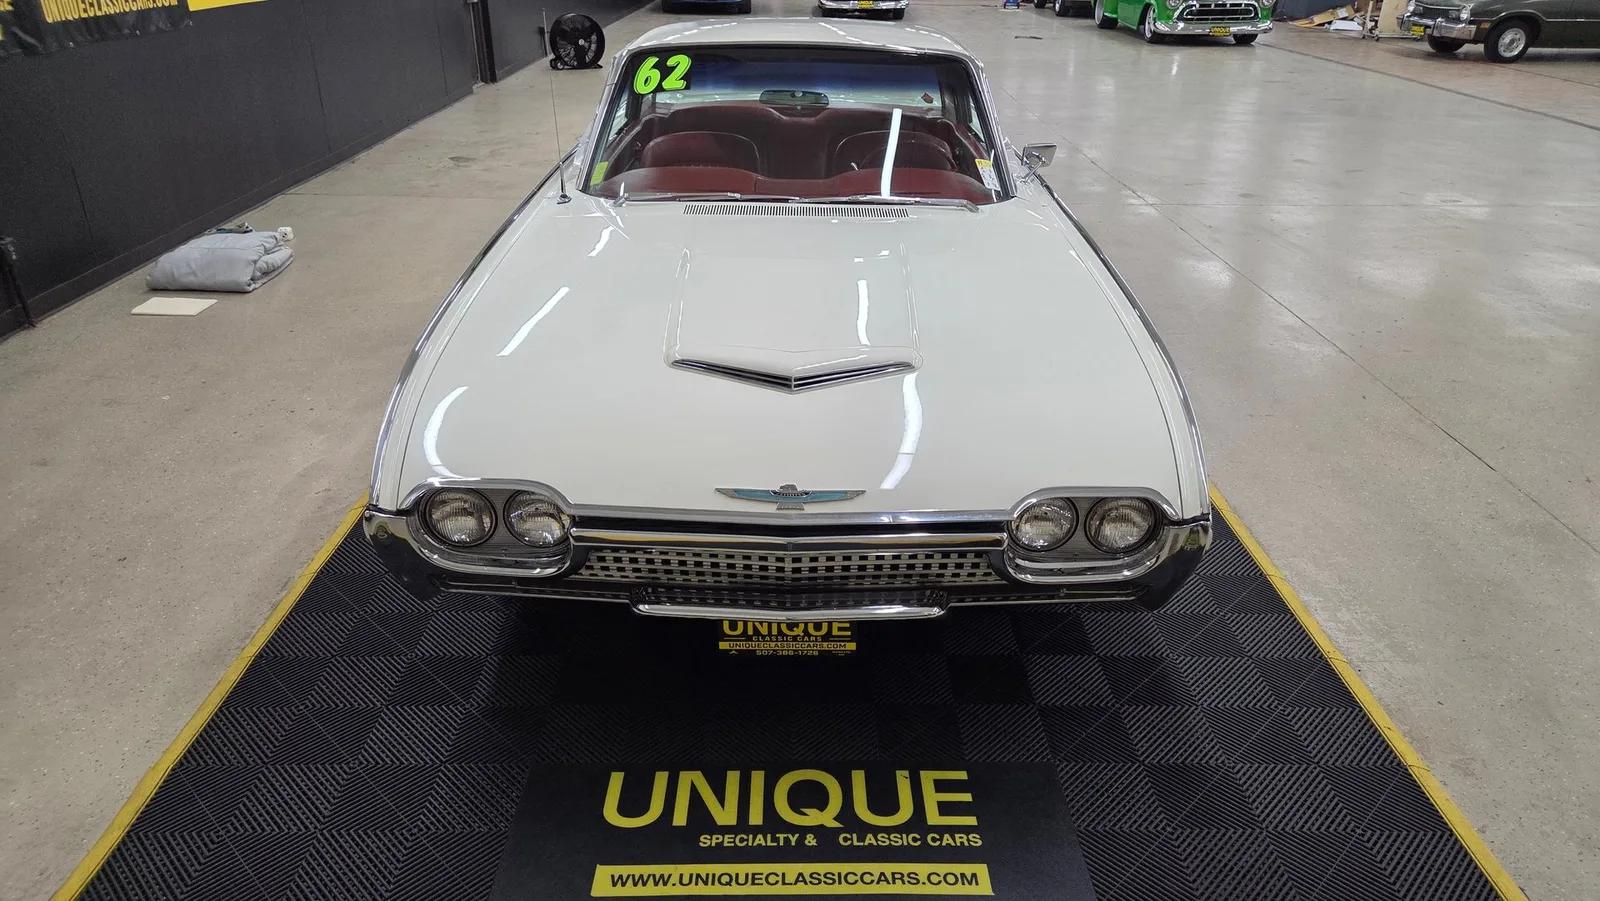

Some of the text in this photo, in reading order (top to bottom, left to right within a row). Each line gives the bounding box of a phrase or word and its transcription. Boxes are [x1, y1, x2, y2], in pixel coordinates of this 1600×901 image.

[41, 0, 178, 23] UNIQUECLASSIC.
[633, 54, 692, 95] 62
[722, 620, 852, 636] UNIQUE
[602, 769, 978, 829] UNIQUE
[699, 832, 983, 848] SPECIALTY & CLASSIC CARS
[610, 871, 980, 888] WWW.UNIQUECLASSICCARS.COM
